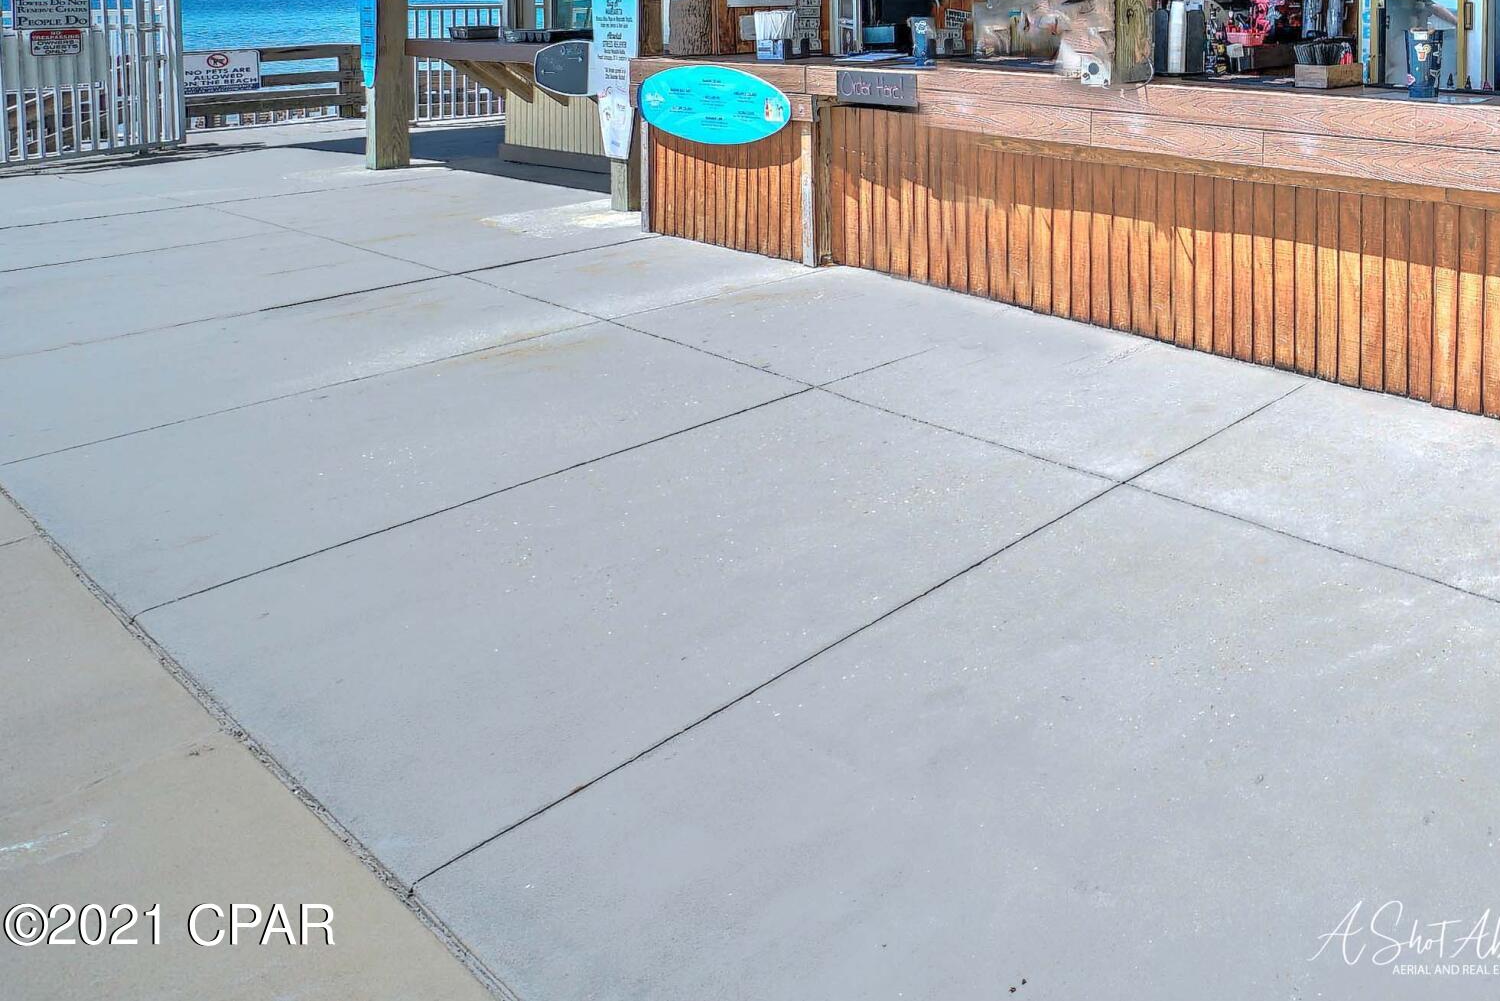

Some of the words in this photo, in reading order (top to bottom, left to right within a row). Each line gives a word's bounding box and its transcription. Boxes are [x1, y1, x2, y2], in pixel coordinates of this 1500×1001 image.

[17, 16, 62, 26] PEOPLE
[65, 15, 88, 25] DO
[841, 72, 872, 96] Order
[876, 76, 904, 99] Here!
